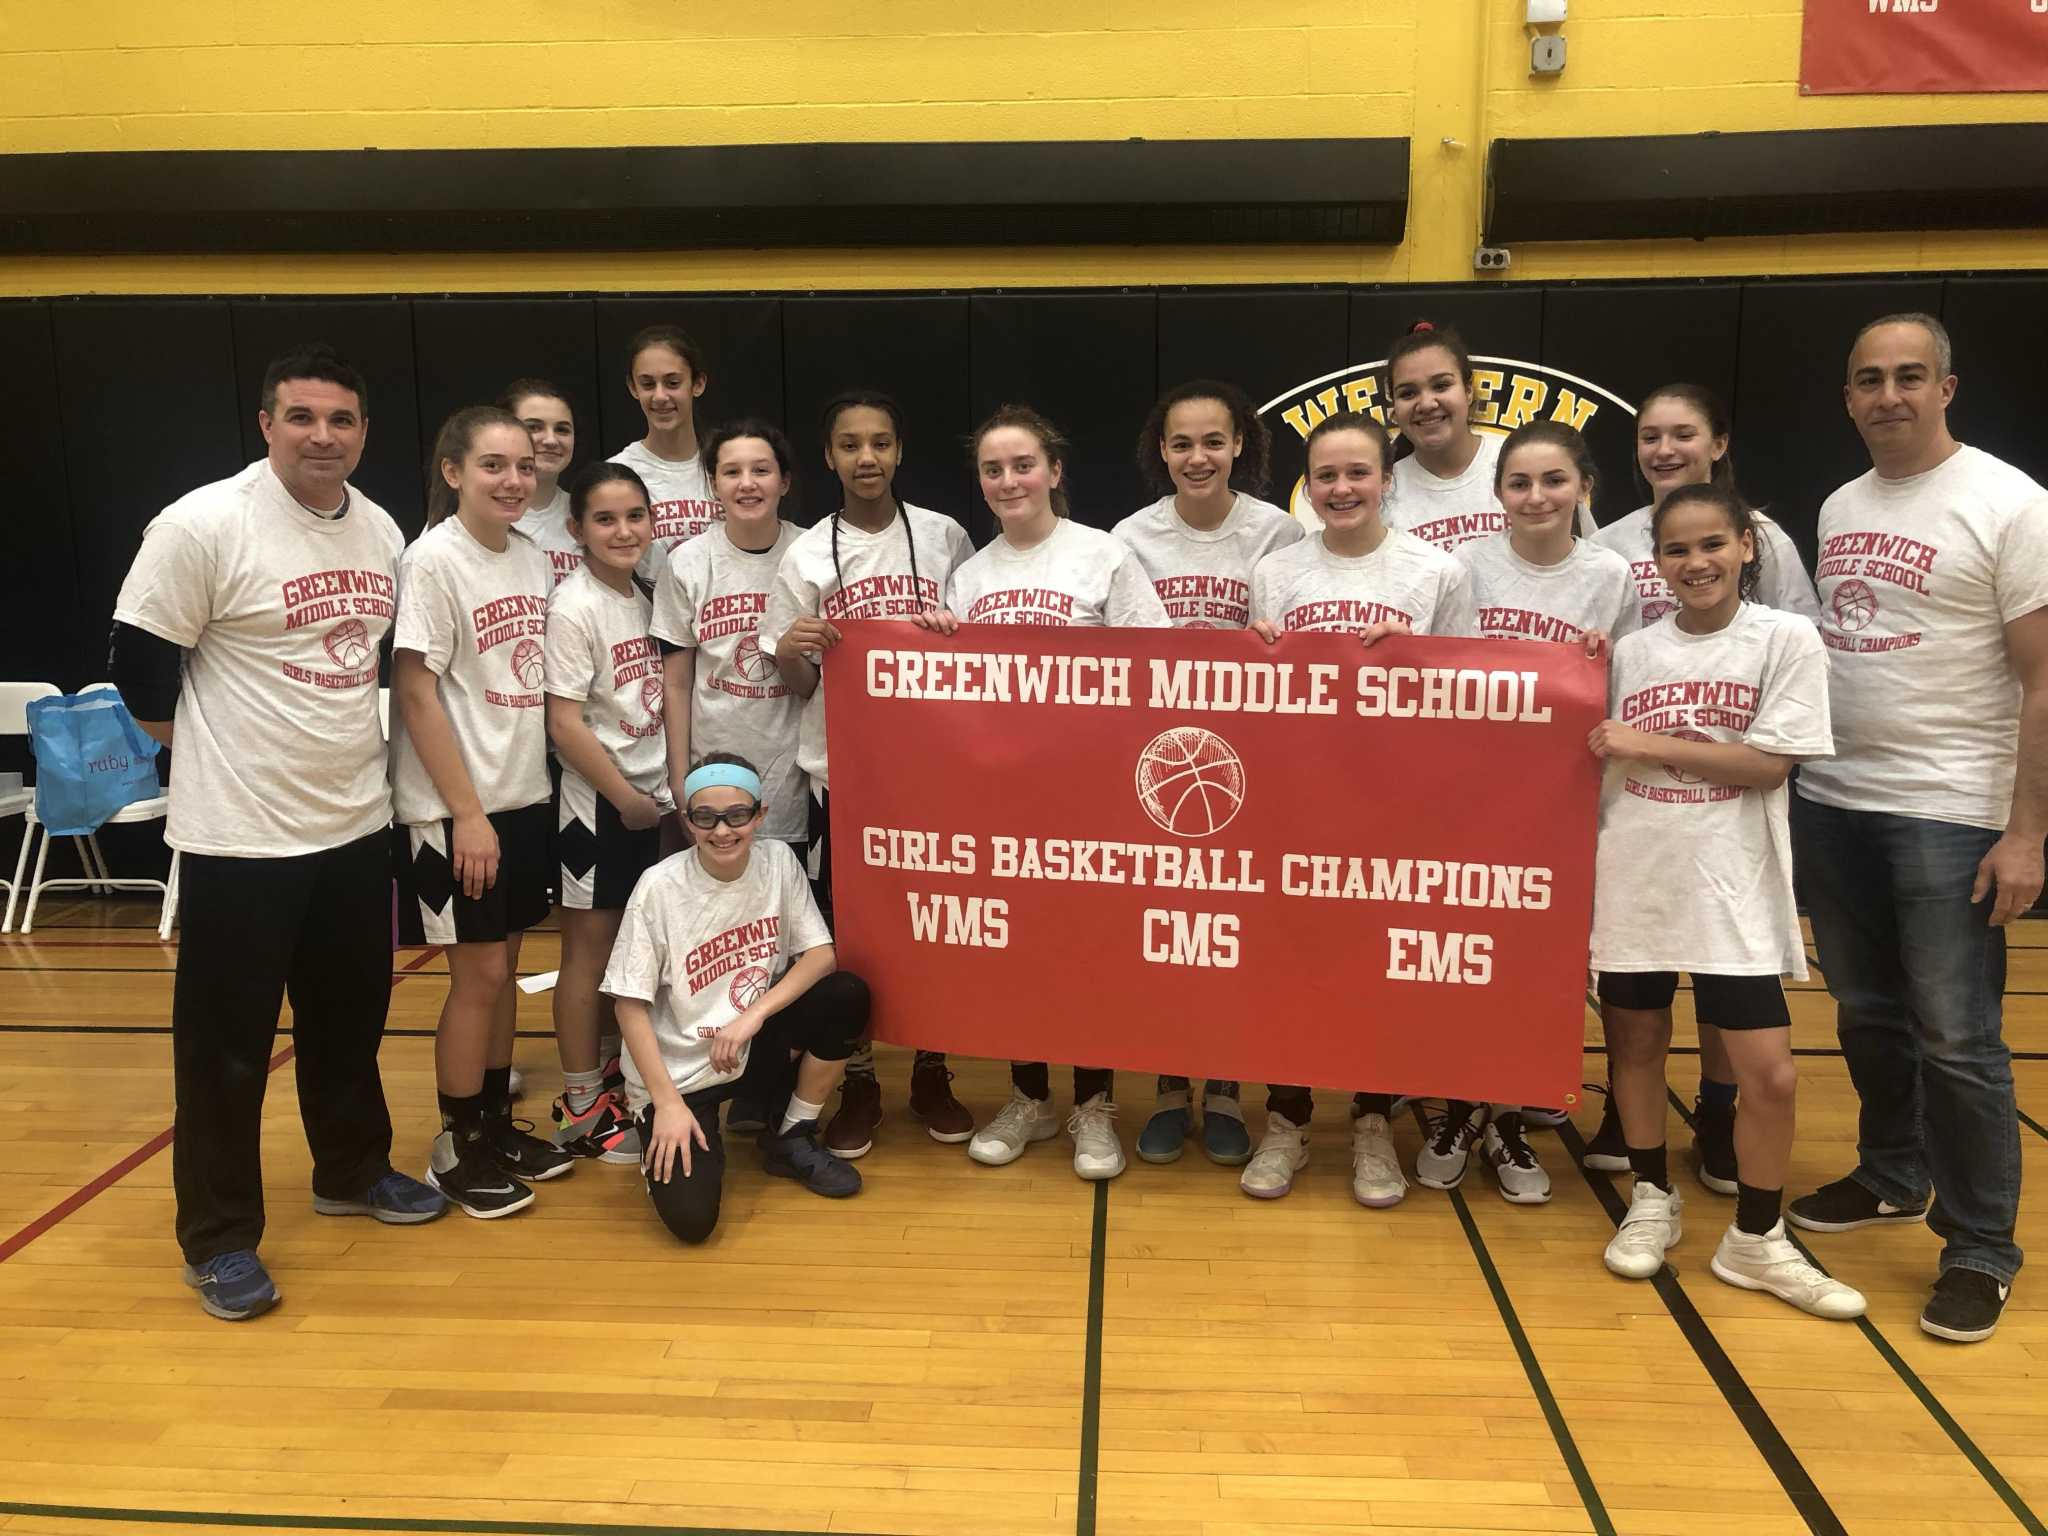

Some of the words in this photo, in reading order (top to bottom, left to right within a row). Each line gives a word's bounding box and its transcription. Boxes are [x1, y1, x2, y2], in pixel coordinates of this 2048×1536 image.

[1282, 370, 1599, 441] WEERN
[651, 500, 724, 522] EENWI
[1408, 512, 1513, 541] EENWICH
[651, 521, 685, 540] DDLE
[282, 569, 394, 609] GREENWICH
[1153, 575, 1249, 606] REENWIC
[1863, 559, 1930, 597] SCHOOL
[701, 593, 770, 624] GREEN
[824, 575, 940, 619] GREENWICH
[841, 601, 881, 619] DDLE
[886, 599, 936, 615] SCHOO
[968, 589, 1074, 624] GREENWICH
[285, 599, 351, 631] MIDDLE
[353, 597, 394, 620] SCHOO
[472, 595, 546, 633] GREENWI
[699, 616, 758, 644] MIDDLE
[1164, 601, 1200, 619] DDLE
[1204, 602, 1249, 627] SCHOO
[1479, 607, 1584, 643] REENWIC
[478, 620, 524, 655] MIDDLE
[611, 637, 660, 670] REENW
[1860, 631, 1922, 653] CHAMPIONS
[282, 661, 313, 684] GIRLS
[314, 670, 360, 690] BASKETBALL
[866, 649, 1132, 707] GREENWICH
[1148, 658, 1340, 715] MIDDLE
[1356, 665, 1552, 723] SCHOOL
[485, 690, 509, 708] GIRLS
[1631, 709, 1689, 733] IDDLE
[1693, 708, 1755, 735] SCHOO
[87, 754, 129, 775] ruby
[1624, 777, 1648, 798] GIRLS
[1647, 784, 1706, 804] BASKETBALL
[863, 826, 976, 875] GIRLS
[991, 835, 1265, 893] BASKETBALL
[1281, 853, 1553, 910] CHAMPIONS
[685, 916, 780, 975] GREENWI
[907, 891, 1009, 949] WMS
[1143, 908, 1240, 969] CMS
[1386, 927, 1494, 985] EMS
[688, 951, 746, 997] MIDDLE
[747, 941, 780, 962] SCH
